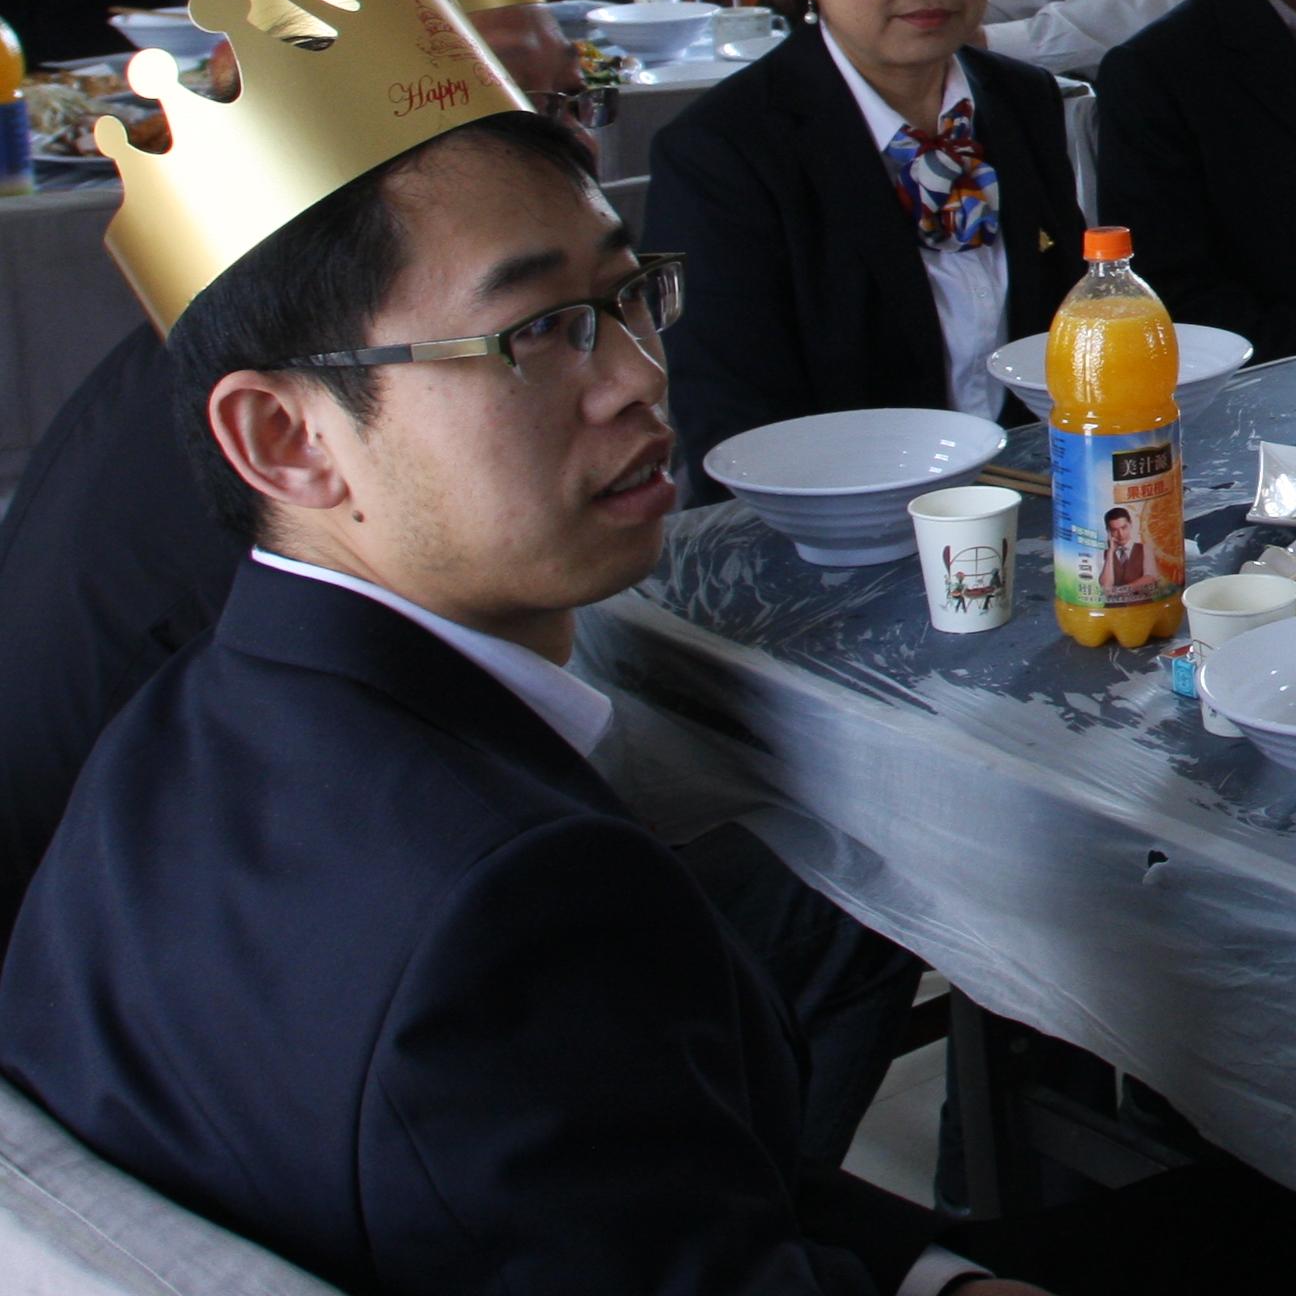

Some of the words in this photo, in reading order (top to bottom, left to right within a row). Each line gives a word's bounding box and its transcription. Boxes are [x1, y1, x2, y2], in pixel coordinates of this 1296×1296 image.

[388, 74, 470, 118] Happy
[1121, 455, 1169, 478] 美汁源
